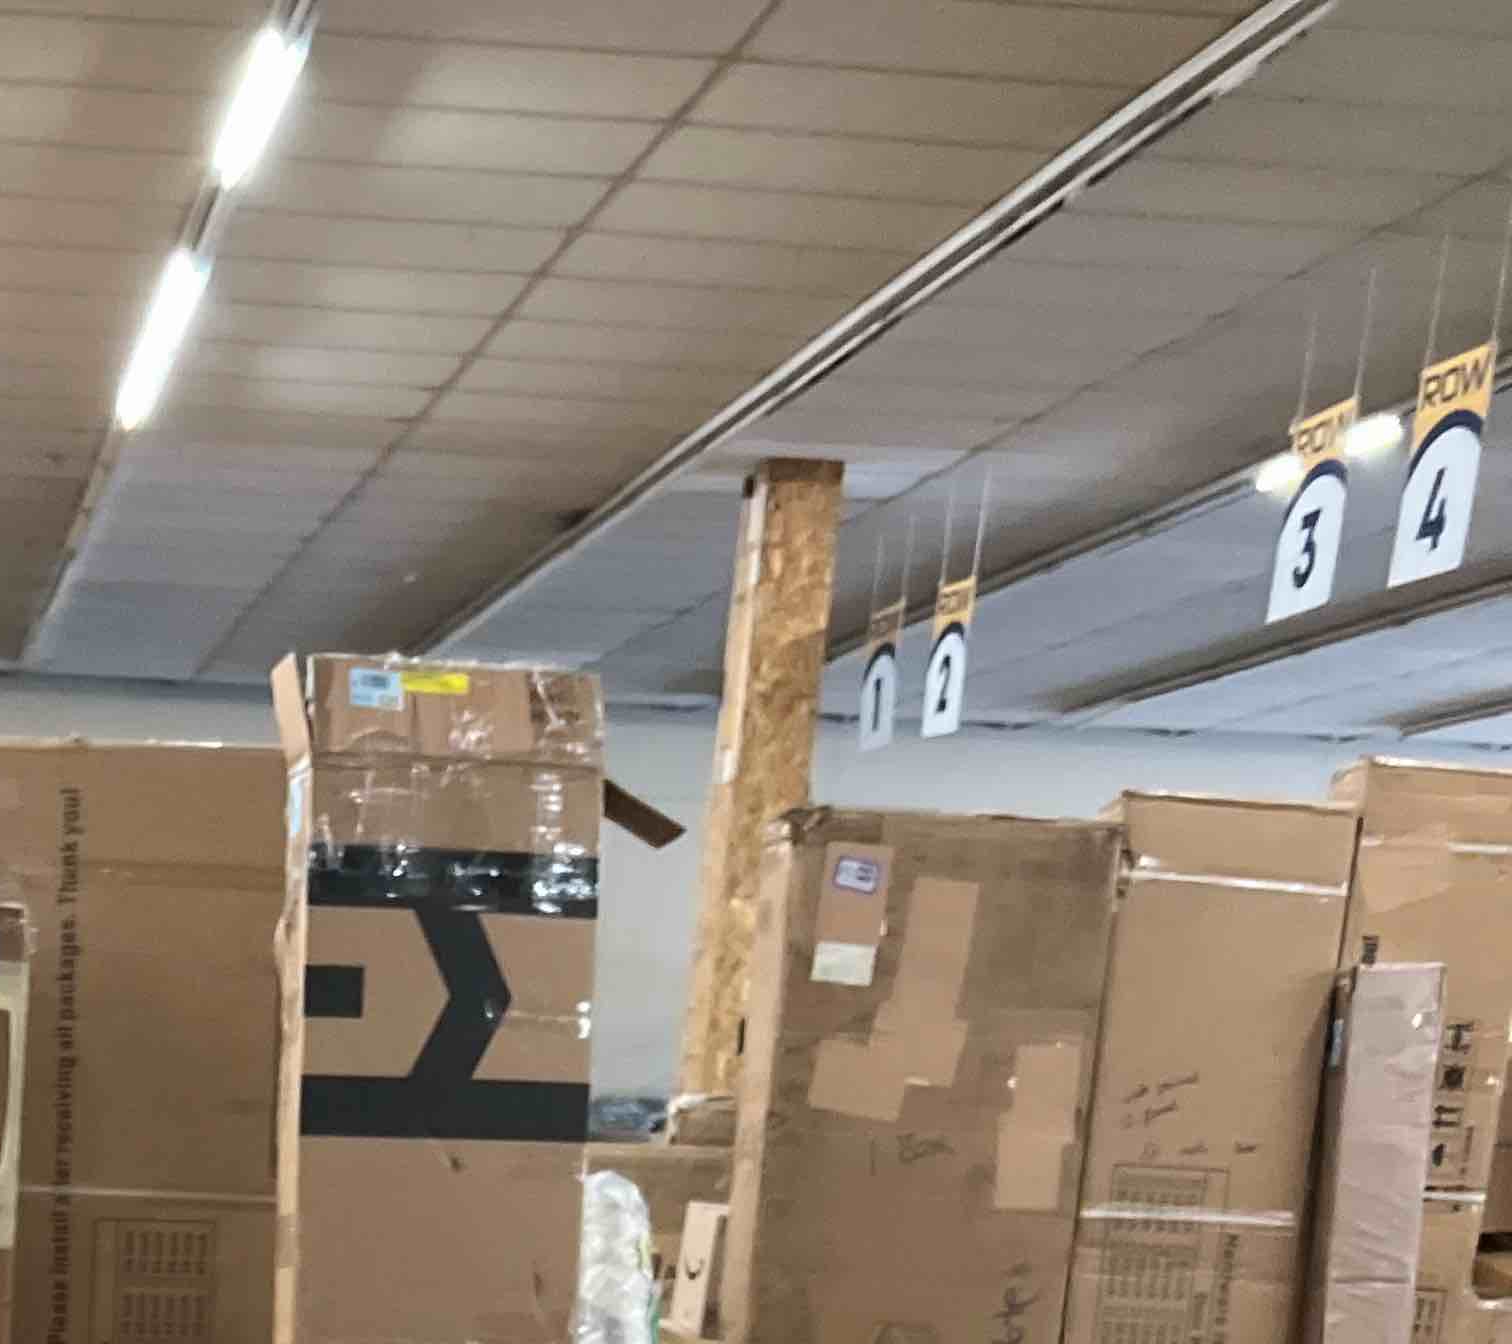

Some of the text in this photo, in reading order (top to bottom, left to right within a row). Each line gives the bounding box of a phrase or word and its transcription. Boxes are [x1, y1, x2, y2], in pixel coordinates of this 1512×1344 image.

[1422, 358, 1490, 409] ROW
[1415, 468, 1447, 552] 4
[1292, 509, 1322, 590] 3
[871, 679, 883, 731] 1
[933, 655, 953, 714] 2
[63, 787, 85, 838] you!
[59, 841, 79, 905] Thank
[54, 1055, 77, 1154] receiving
